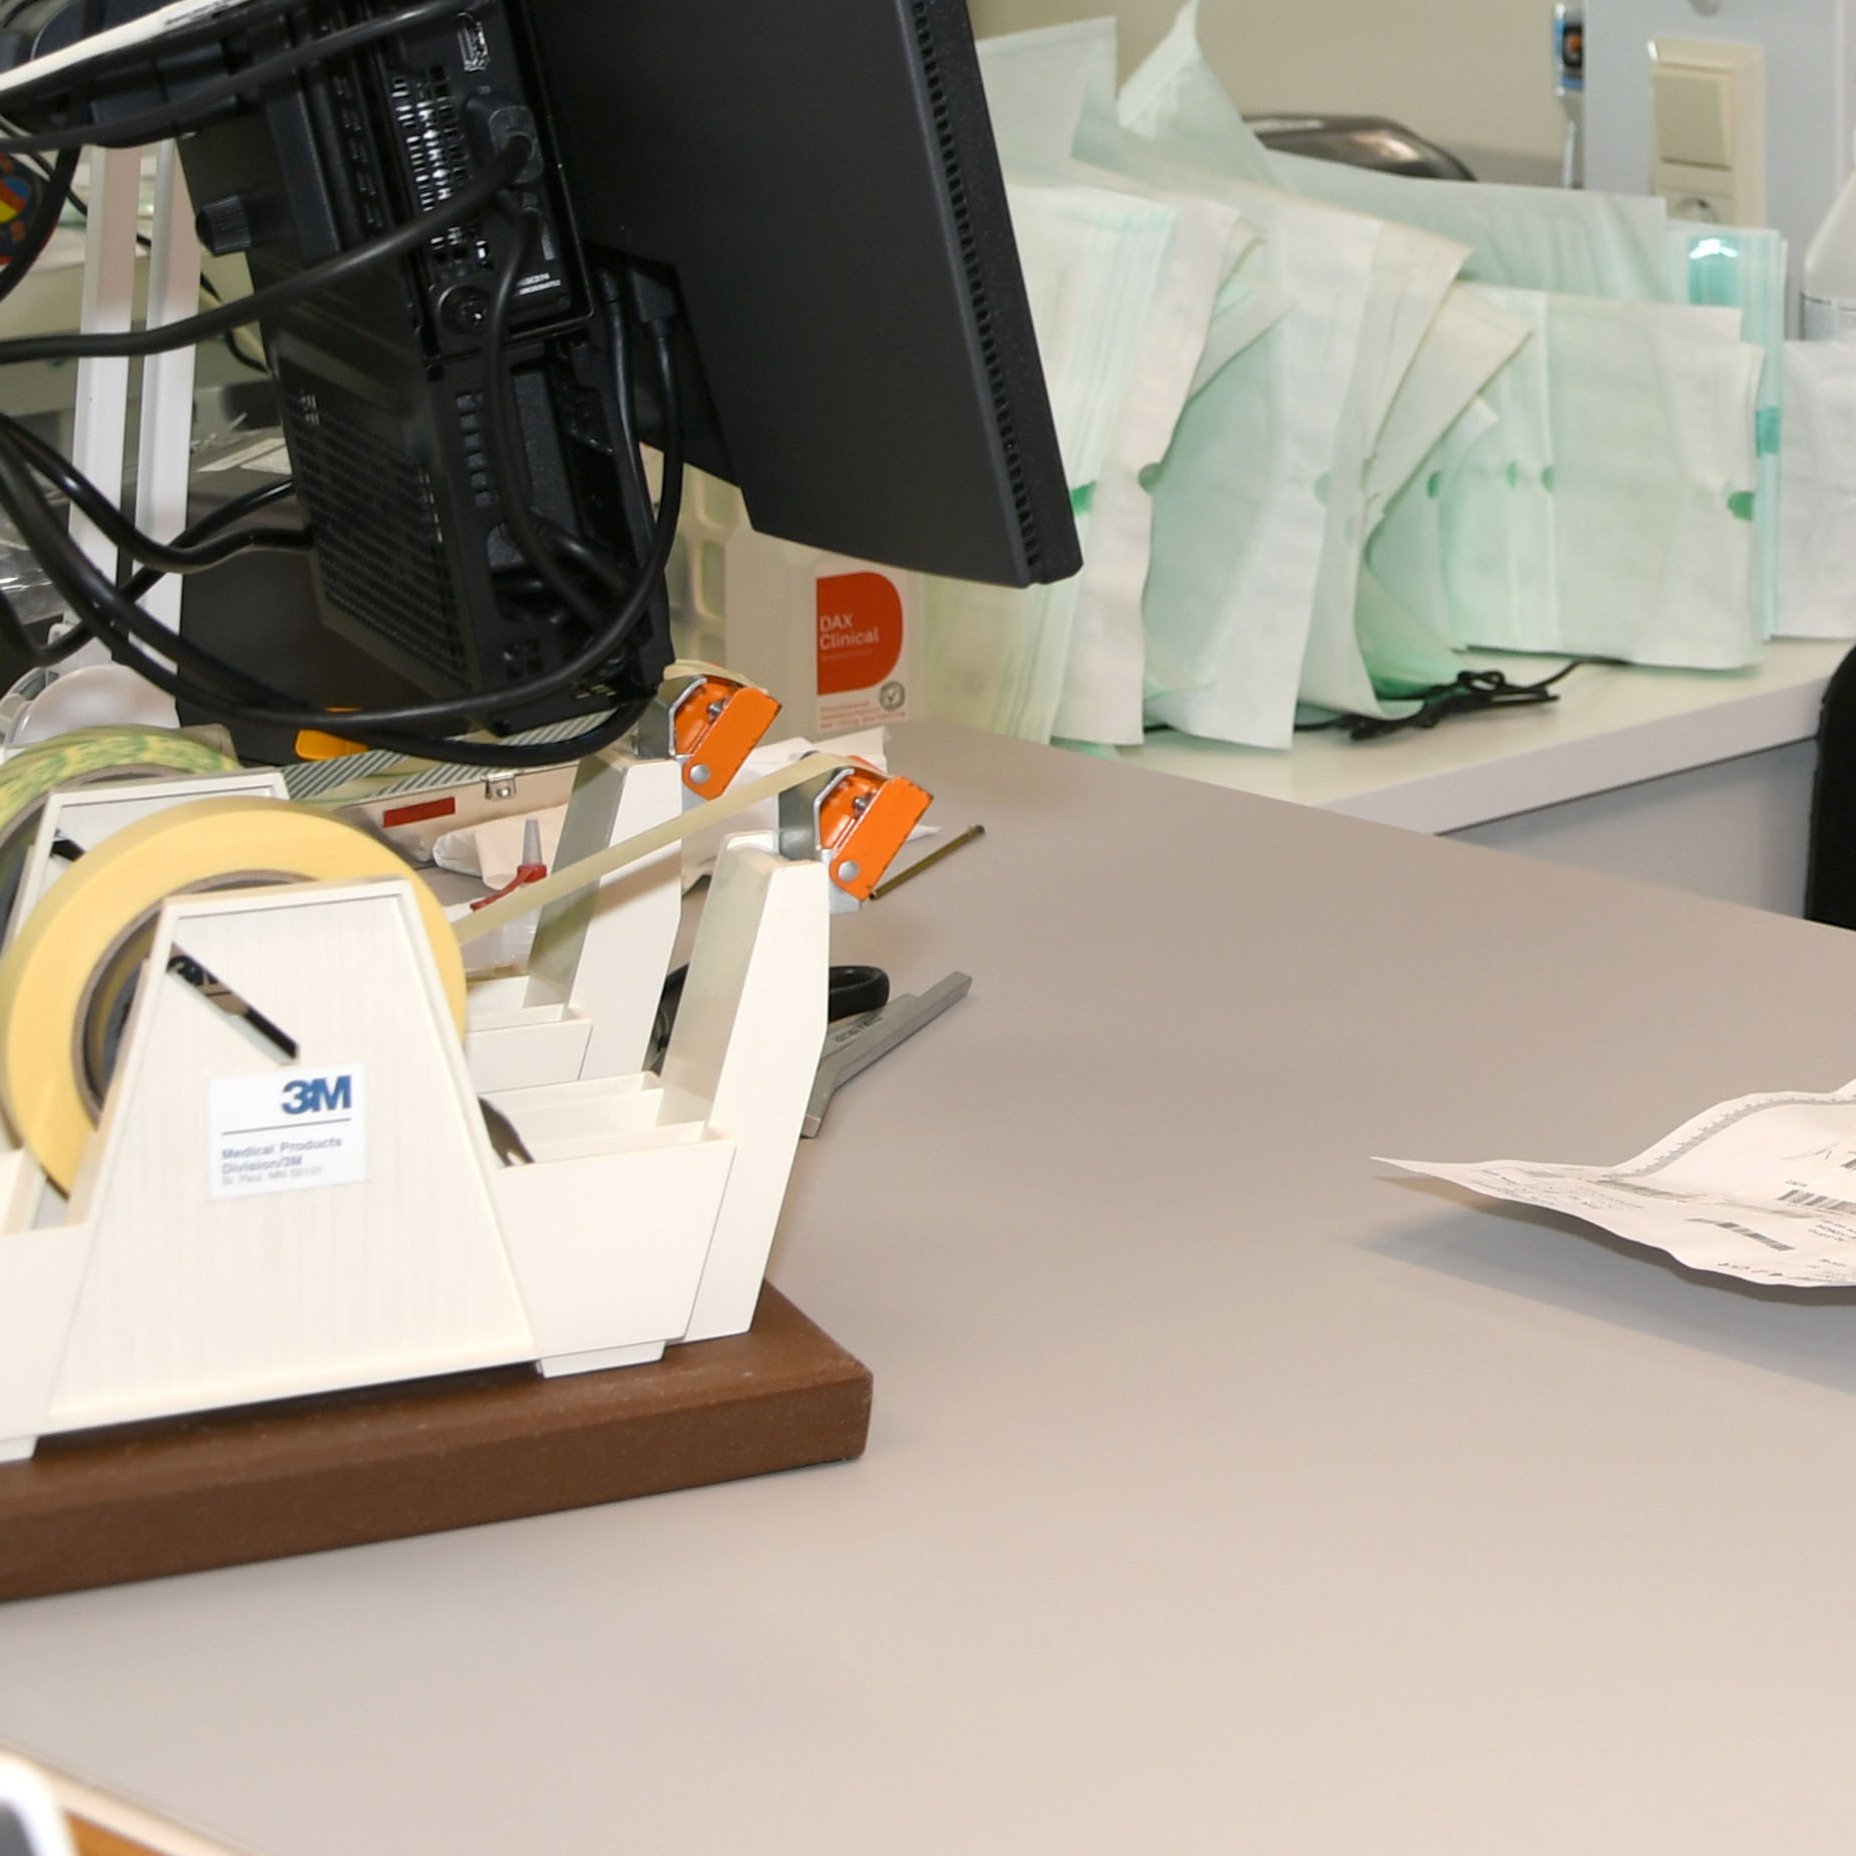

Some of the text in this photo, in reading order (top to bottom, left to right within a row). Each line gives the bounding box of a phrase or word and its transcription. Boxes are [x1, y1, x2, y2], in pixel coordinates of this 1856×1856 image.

[820, 613, 853, 632] DAX
[281, 1074, 352, 1115] 3M
[222, 1137, 342, 1159] Medical Products
